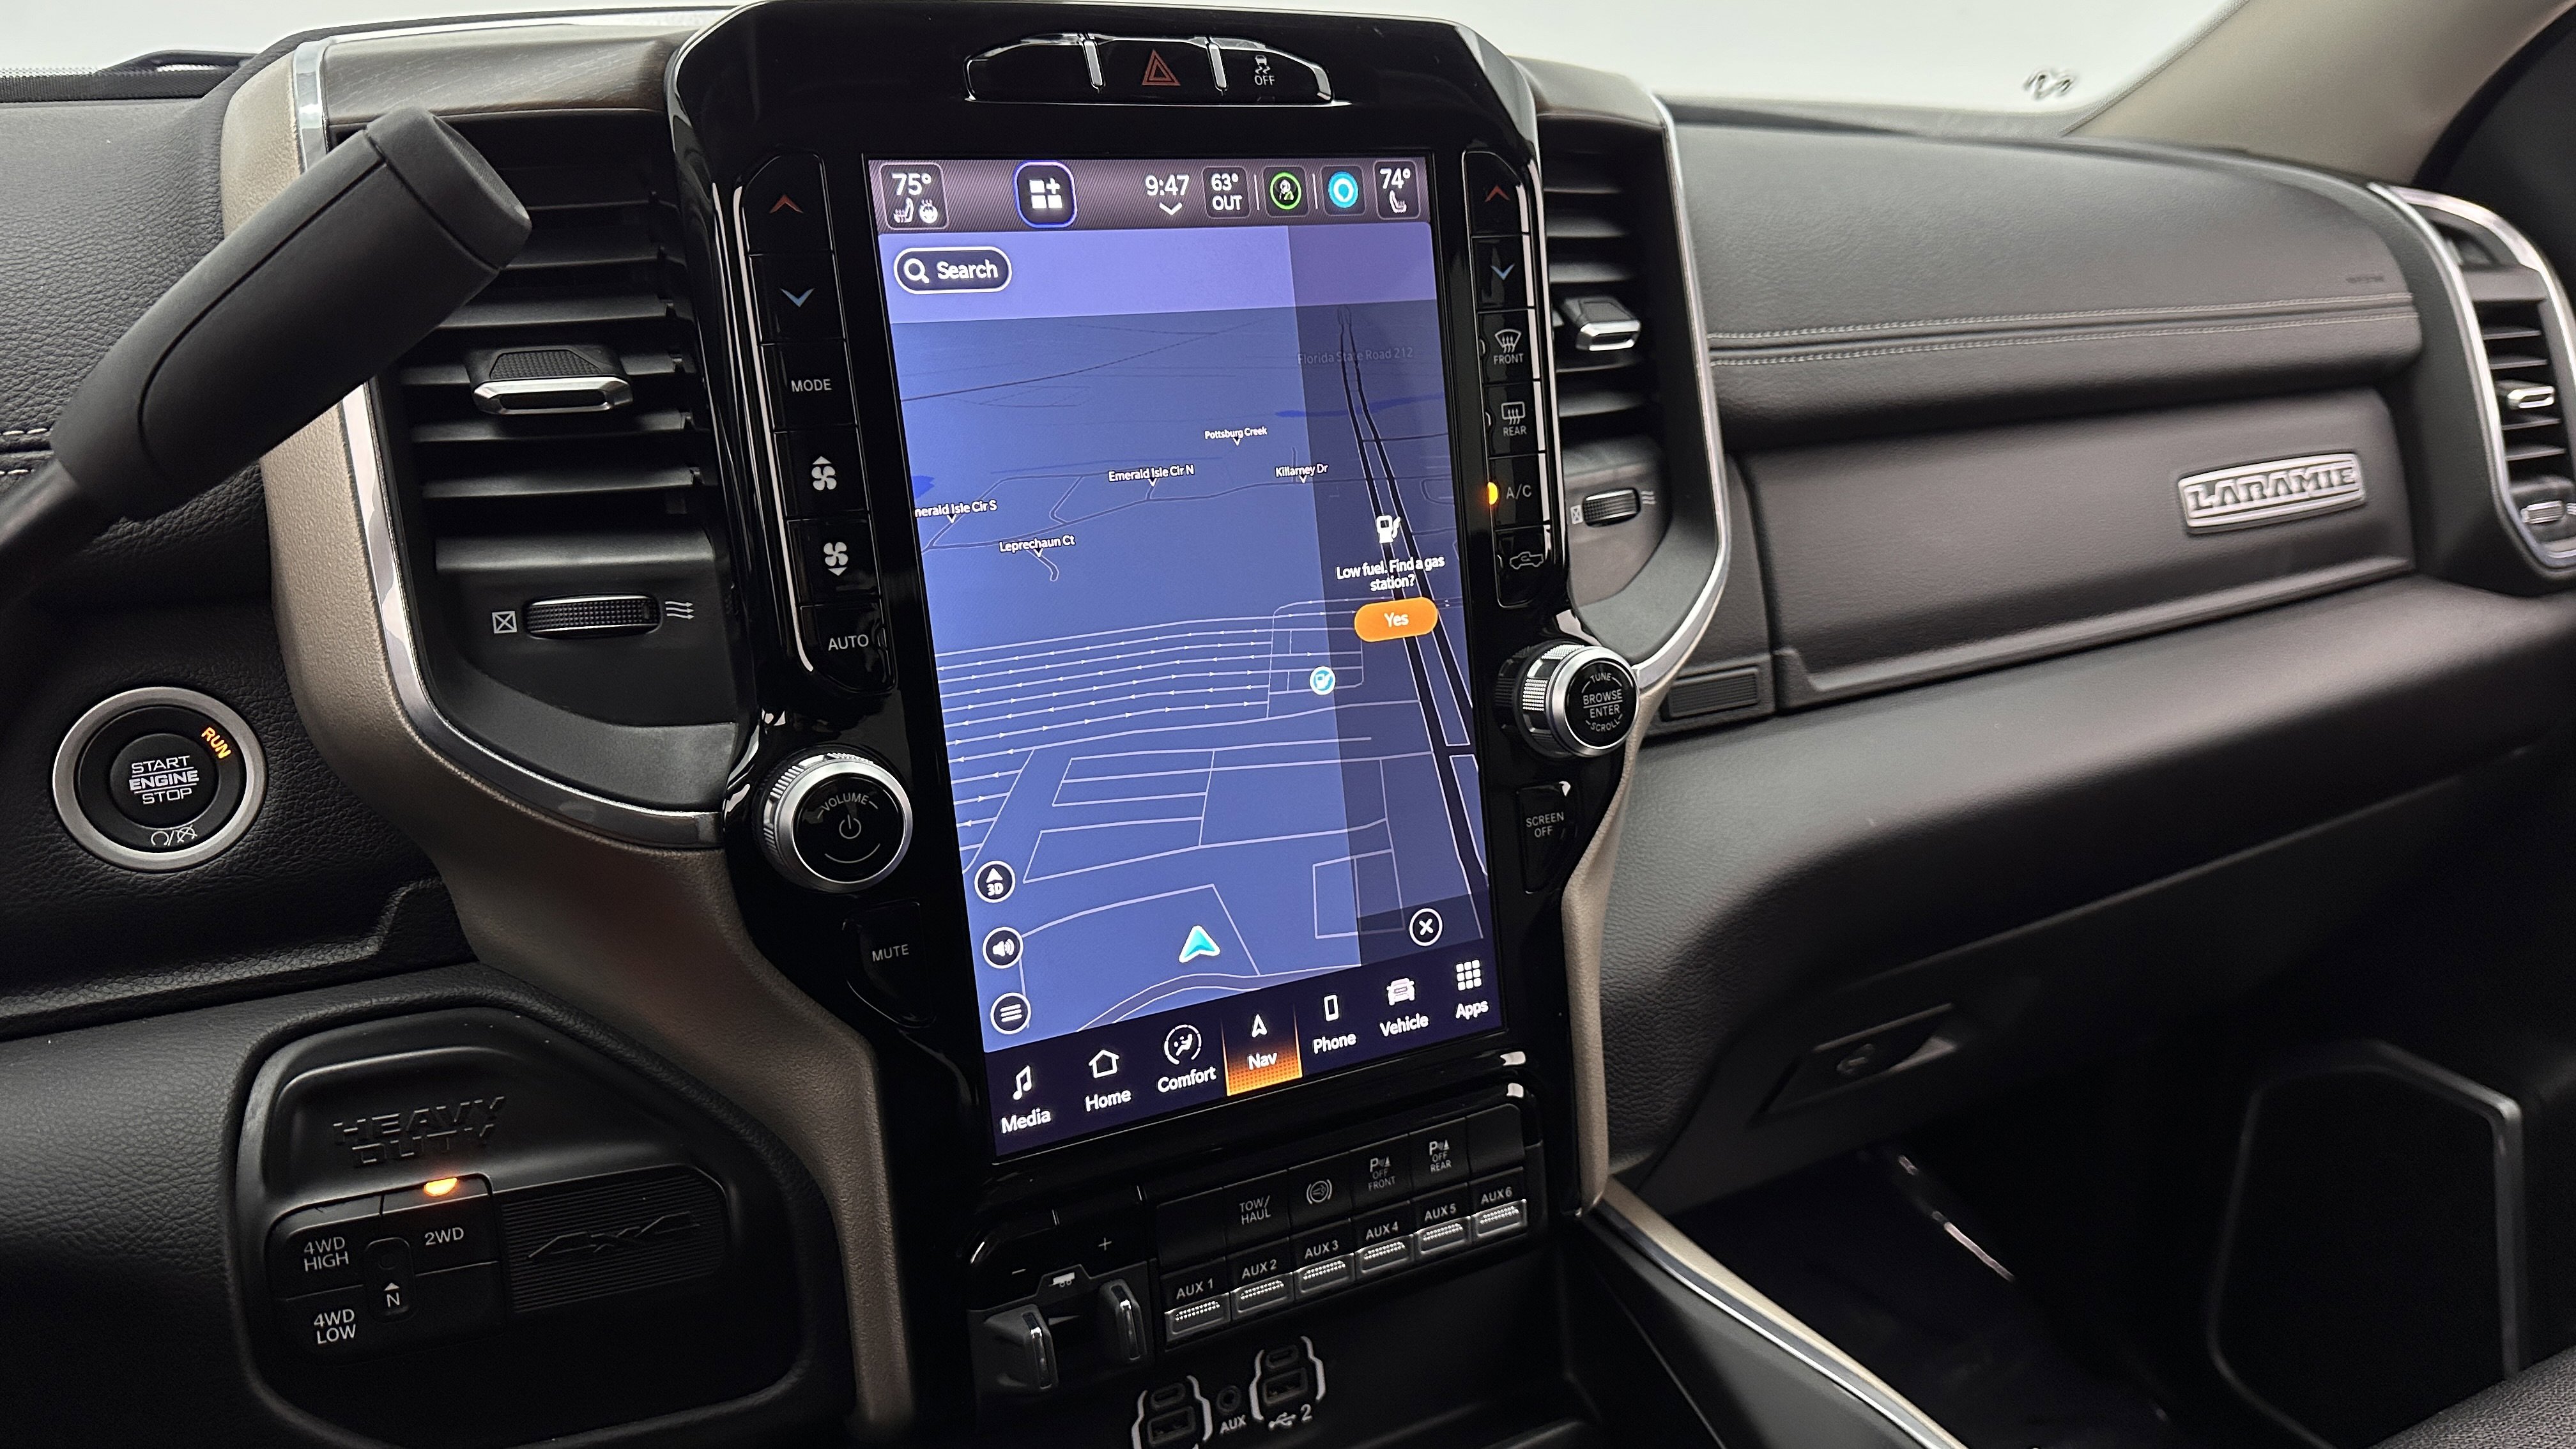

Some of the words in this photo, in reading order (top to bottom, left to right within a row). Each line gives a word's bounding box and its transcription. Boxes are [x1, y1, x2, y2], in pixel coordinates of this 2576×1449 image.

[1255, 75, 1275, 86] OFF
[892, 172, 931, 195] 75°
[1145, 174, 1190, 197] 9:47
[1211, 173, 1239, 192] 63°
[1380, 168, 1411, 189] 74°
[1213, 195, 1242, 211] OUT
[937, 259, 998, 279] Search
[1298, 352, 1335, 365] Florida
[1336, 351, 1363, 362] Stae
[1365, 348, 1392, 360] Road
[1394, 346, 1413, 359] 212
[1493, 353, 1524, 365] FRONT
[791, 378, 832, 392] MODE
[1204, 429, 1244, 440] Pottsburg
[1244, 426, 1268, 436] Creek
[1503, 425, 1527, 436] REAR
[1108, 468, 1150, 482] Emerald
[1151, 466, 1169, 478] Isle
[1169, 465, 1184, 476] Cir
[1185, 464, 1194, 475] N
[1275, 466, 1315, 477] Killarney
[1316, 463, 1328, 474] Dr
[1506, 484, 1532, 500] A/C
[2183, 463, 2356, 517] LARAMIE
[951, 502, 970, 514] Isle
[971, 500, 988, 512] Cir
[988, 500, 997, 510] S
[999, 537, 1061, 553] Leprechaun
[1062, 535, 1075, 546] Ct
[1336, 566, 1361, 579] Low
[1362, 560, 1388, 576] fuel.
[1389, 556, 1414, 572] Find
[1415, 558, 1423, 570] a
[1424, 556, 1445, 571] gas
[1370, 573, 1416, 592] station?
[1384, 611, 1409, 628] Yes
[828, 634, 869, 651] AUTO
[1590, 672, 1612, 684] TUNE
[1583, 689, 1622, 705] BROWSE
[1590, 705, 1620, 719] ENTER
[1591, 717, 1620, 732] SCROLL
[201, 726, 231, 759] RUN
[131, 755, 190, 774] START
[129, 770, 199, 791] ENGINE
[142, 787, 192, 804] STOP
[822, 792, 870, 812] VOLUME
[1526, 811, 1565, 827] SCREEN
[1534, 825, 1553, 838] OFF
[986, 882, 1004, 896] 3D
[872, 944, 910, 962] MUTE
[1455, 1000, 1489, 1020] Apps
[1379, 1013, 1429, 1038] Vehicle
[1313, 1033, 1356, 1054] Phone
[1248, 1052, 1278, 1070] Nav
[1157, 1066, 1216, 1093] Comfort
[1085, 1089, 1131, 1112] Home
[332, 1095, 505, 1145] HEAVY
[1000, 1108, 1052, 1134] Media
[351, 1123, 496, 1168] DUTY
[1430, 1160, 1452, 1173] REAR
[1432, 1151, 1448, 1163] OFF
[1372, 1168, 1388, 1179] OFF
[1368, 1176, 1396, 1192] FRONT
[1239, 1195, 1271, 1213] TOW/
[1480, 1188, 1505, 1206] AUX
[1505, 1186, 1513, 1198] 6
[1241, 1208, 1271, 1225] HAUL
[1424, 1206, 1449, 1222] AUX
[1450, 1203, 1457, 1214] 5
[424, 1227, 464, 1246] 2WD
[1365, 1223, 1390, 1241] AUX
[1391, 1221, 1399, 1232] 4
[303, 1236, 346, 1255] 4WD
[1304, 1241, 1330, 1260] AUX
[1332, 1239, 1339, 1251] 3
[303, 1251, 349, 1272] HIGH
[1241, 1261, 1268, 1279] AUX
[1269, 1259, 1277, 1269] 2
[1176, 1281, 1204, 1300] AUX
[1208, 1278, 1214, 1289] 1
[386, 1292, 401, 1308] N
[314, 1309, 355, 1328] 4WD
[316, 1324, 356, 1344] LOW
[1300, 1404, 1313, 1423] 2
[1220, 1414, 1246, 1435] AUX
